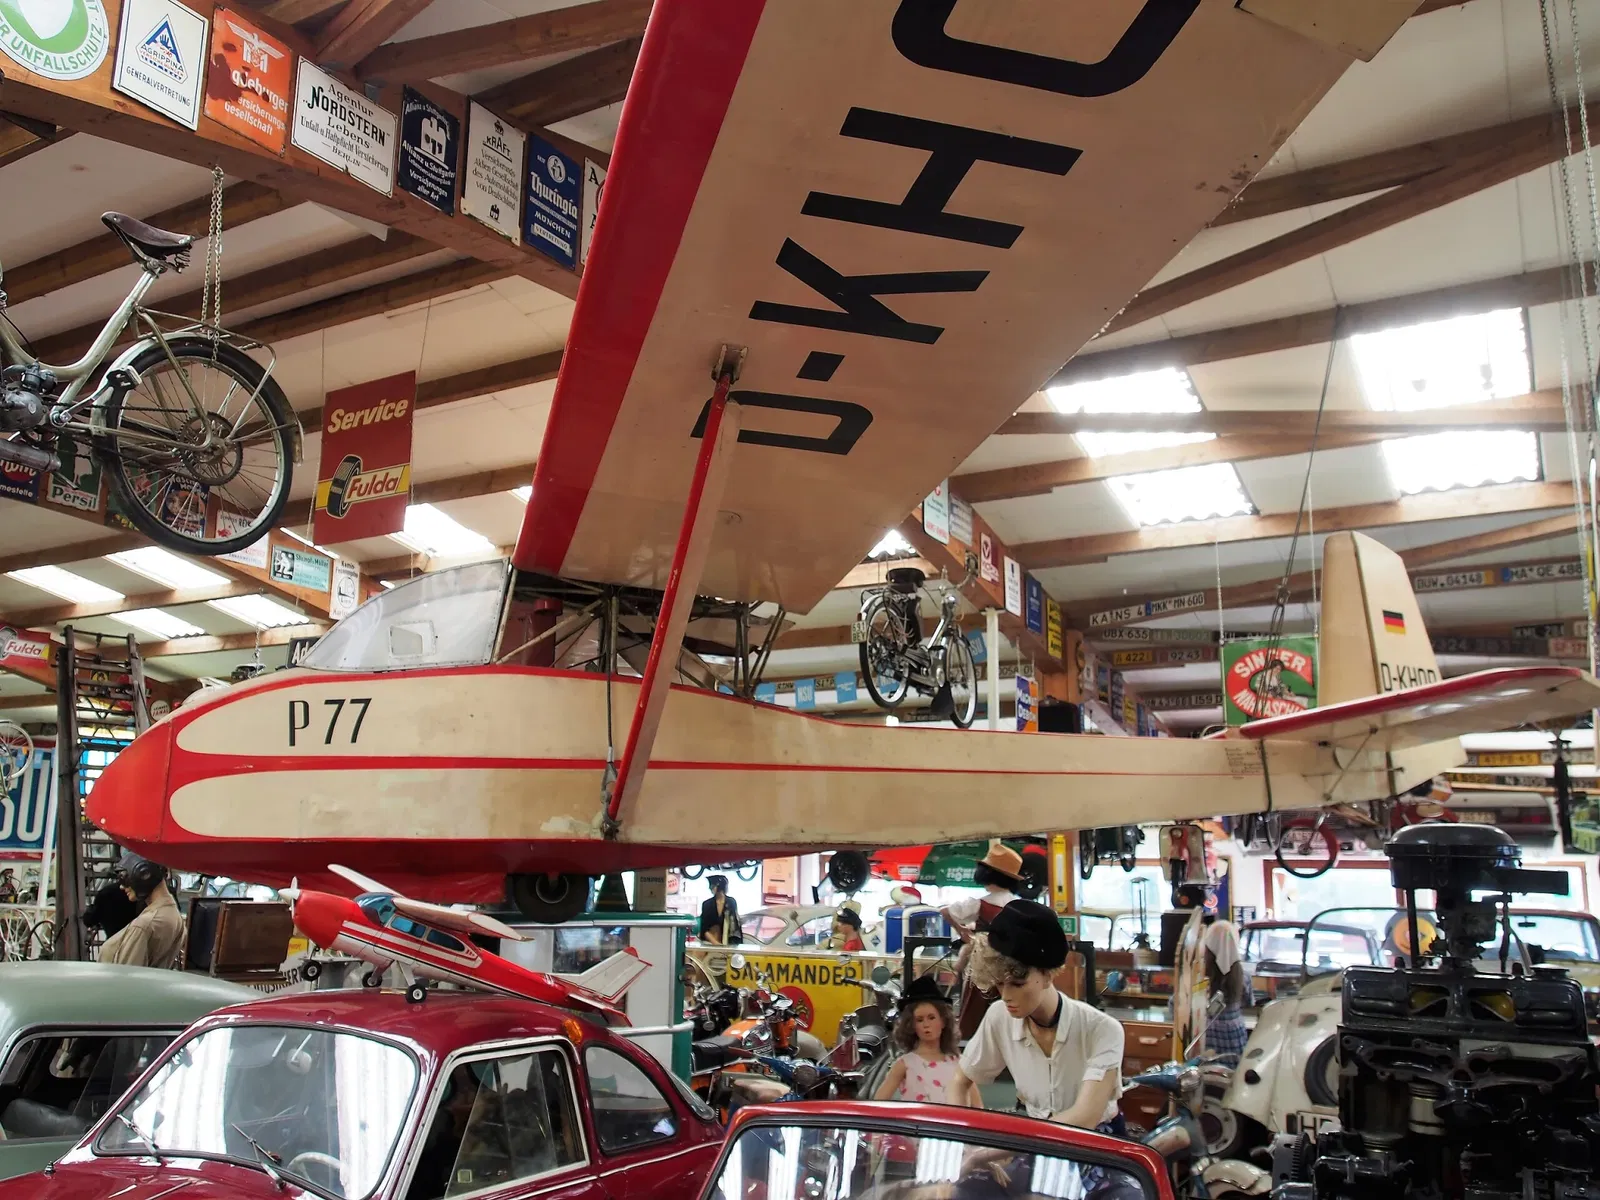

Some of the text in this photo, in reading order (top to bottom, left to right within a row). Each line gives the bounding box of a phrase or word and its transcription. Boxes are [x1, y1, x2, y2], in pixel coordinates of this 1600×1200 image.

[10, 23, 102, 71] UNFALLSCHUTZ
[140, 44, 185, 73] AGRIPPINA
[126, 65, 191, 107] GENERALVERTRETUNG
[328, 83, 374, 117] Agentur
[224, 100, 273, 135] Gesellschaft
[332, 146, 361, 166] BERLIN
[402, 139, 424, 165] Allianz
[530, 171, 578, 220] Thuringia
[327, 399, 409, 434] Service
[52, 486, 97, 510] Persil
[347, 472, 400, 500] Fulda
[6, 641, 42, 656] Fulda
[291, 640, 312, 664] Ad
[289, 698, 372, 746] P 77
